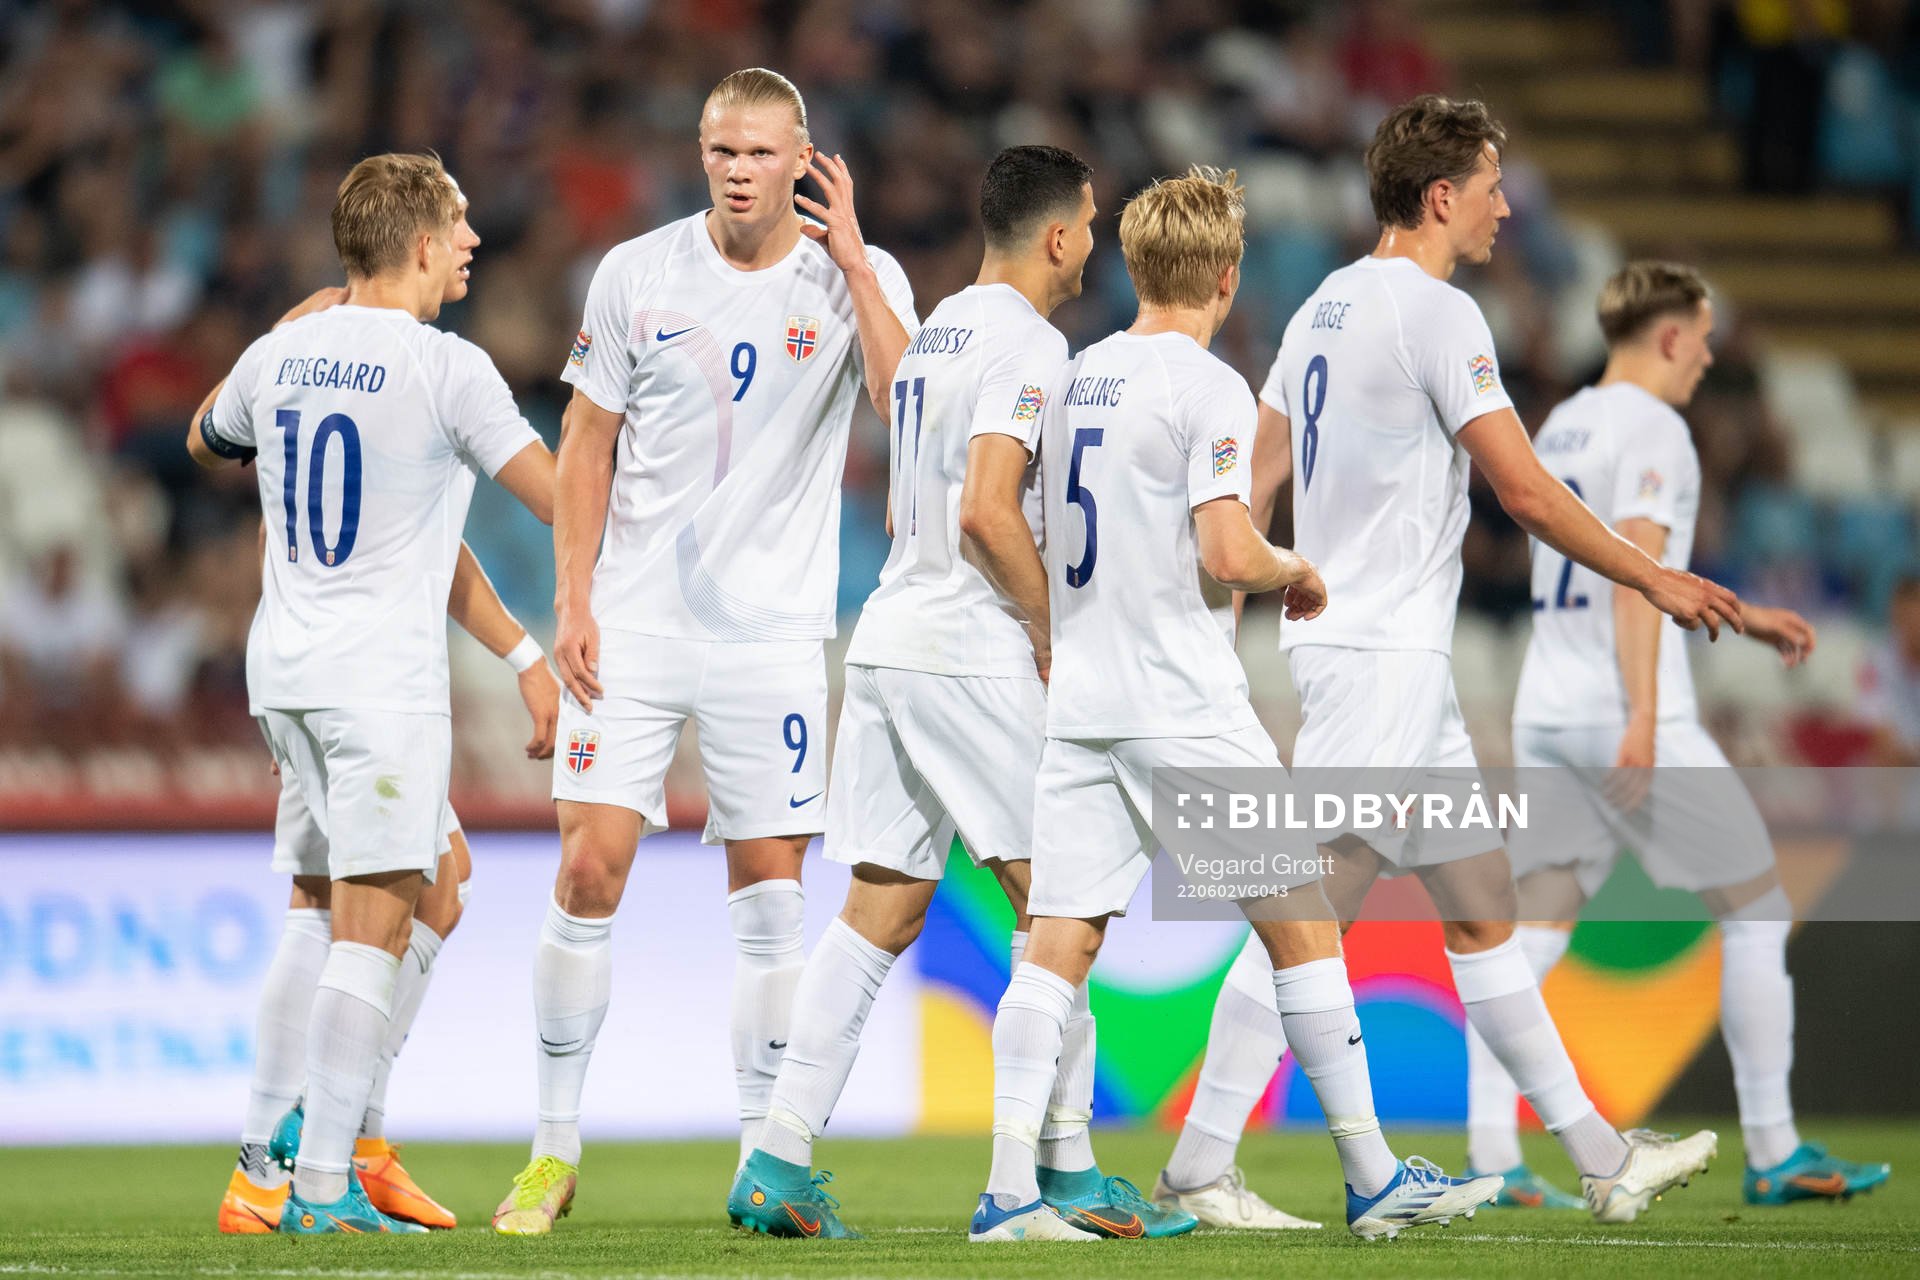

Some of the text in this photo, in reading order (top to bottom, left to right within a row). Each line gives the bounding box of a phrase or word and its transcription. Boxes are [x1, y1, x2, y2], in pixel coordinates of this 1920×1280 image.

[275, 357, 387, 394] ØDEGAARD
[731, 341, 757, 401] 9
[1063, 376, 1126, 407] MELING
[895, 377, 926, 536] 11
[1302, 354, 1328, 493] 8
[275, 409, 363, 567] 10
[1066, 428, 1104, 589] 5
[783, 713, 808, 773] 9
